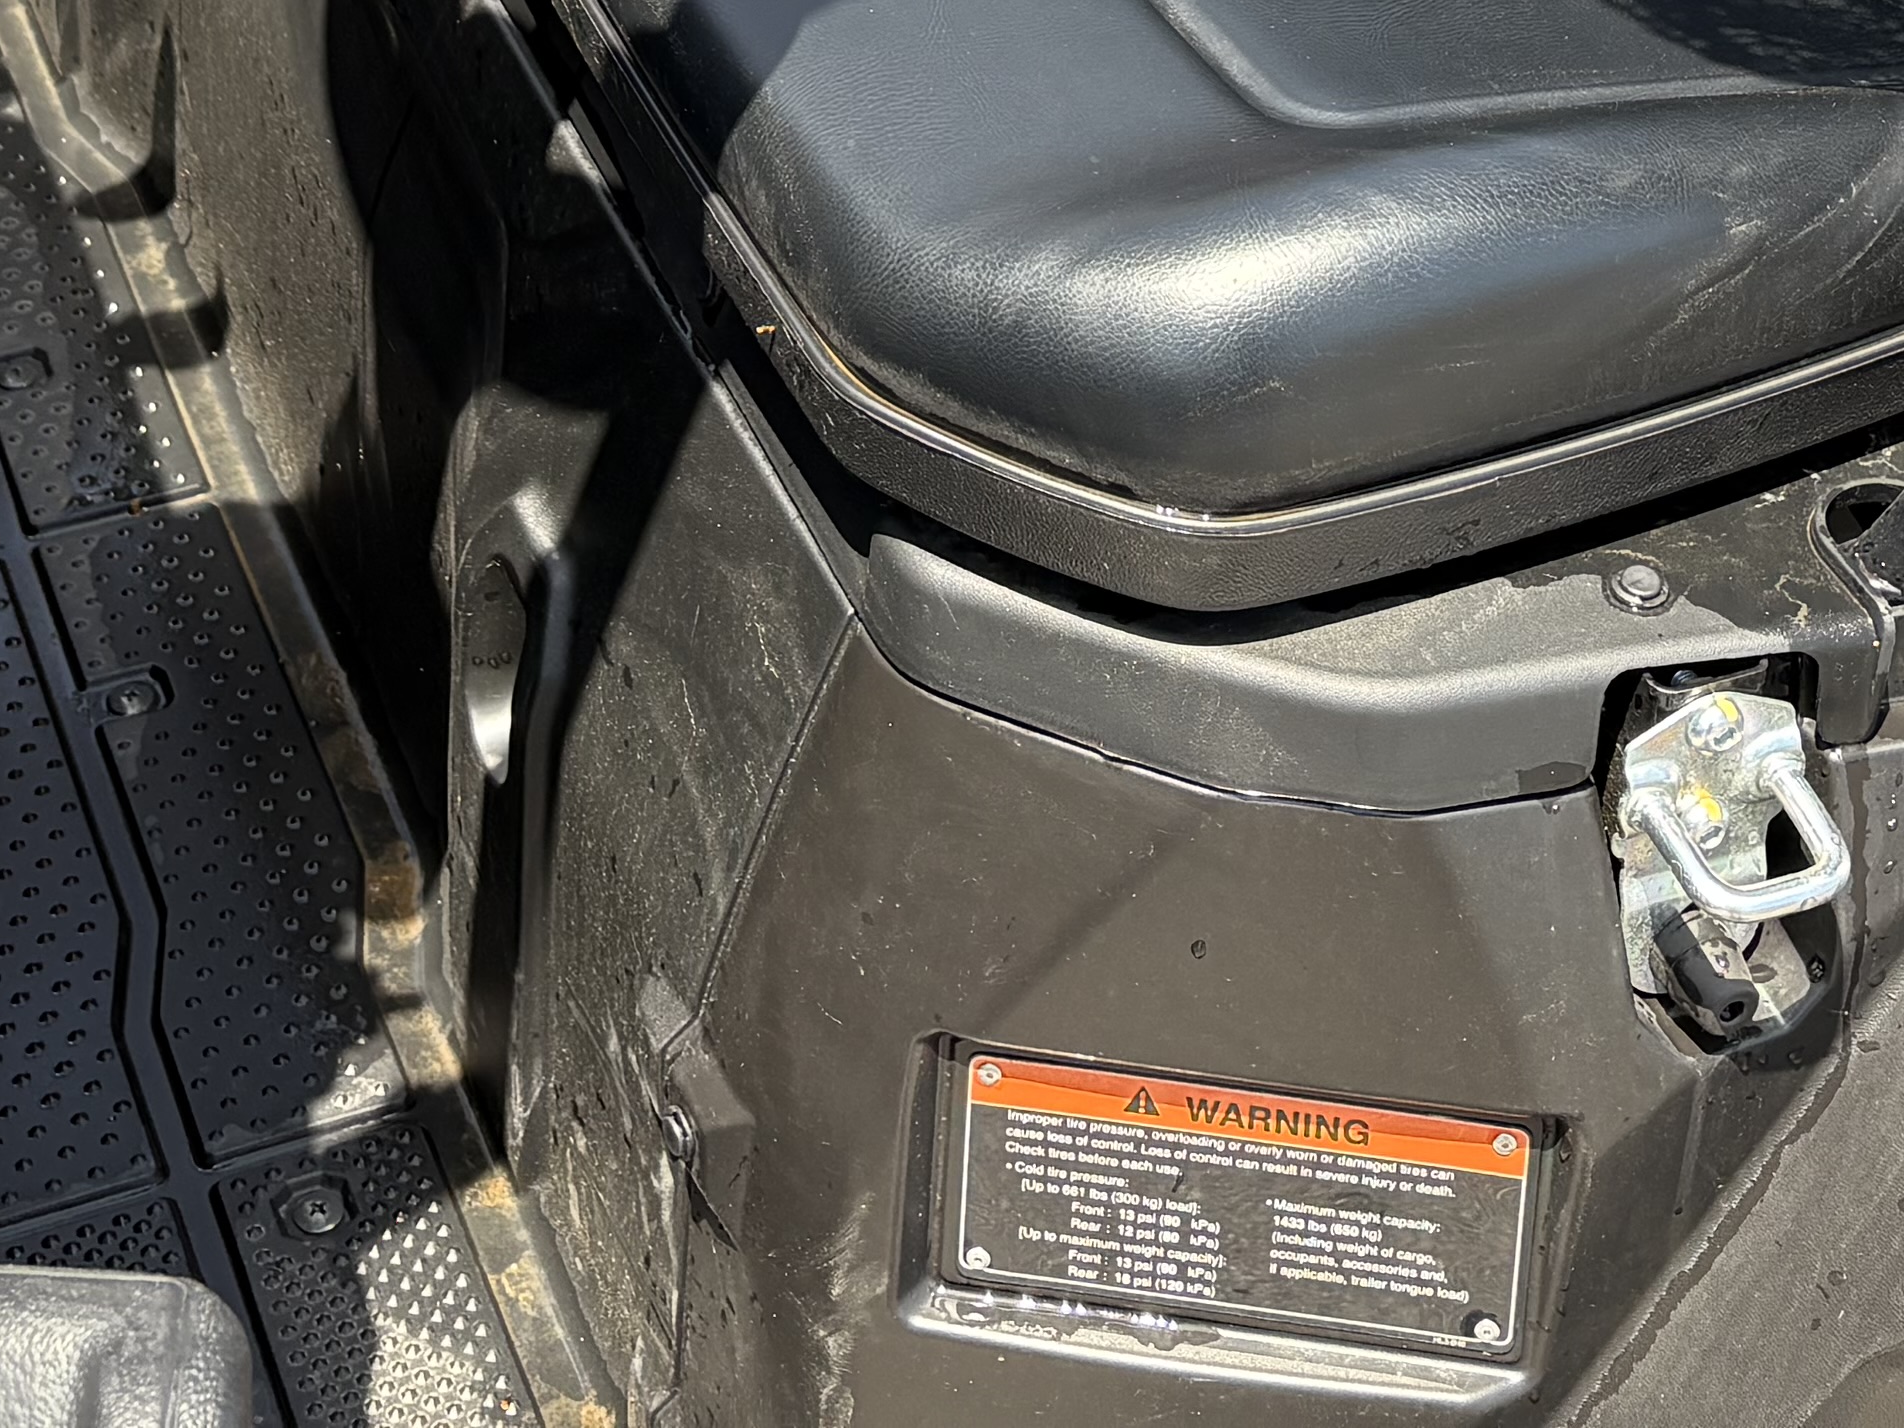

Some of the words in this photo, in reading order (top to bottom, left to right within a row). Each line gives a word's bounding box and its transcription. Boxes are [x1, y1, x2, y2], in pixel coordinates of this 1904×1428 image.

[1185, 1097, 1370, 1146] WARNING
[1005, 1142, 1045, 1157] Check
[1049, 1148, 1076, 1162] tires
[1079, 1152, 1118, 1168] before
[1122, 1158, 1153, 1173] each
[1007, 1109, 1063, 1129] Improper
[1067, 1118, 1086, 1130] tire
[1090, 1122, 1148, 1141] pressure,
[1152, 1130, 1225, 1152] overloading
[1228, 1142, 1242, 1153] or
[1245, 1144, 1283, 1160] overly
[1286, 1150, 1317, 1163] worn
[1321, 1155, 1334, 1165] or
[1338, 1156, 1396, 1175] damaged
[1400, 1165, 1427, 1178] tires
[1431, 1170, 1454, 1181] can
[1006, 1126, 1043, 1141] cause
[1047, 1131, 1072, 1144] loss
[1076, 1135, 1088, 1147] of
[1091, 1138, 1137, 1154] control.
[1141, 1144, 1172, 1159] Loss
[1175, 1148, 1187, 1160] of
[1190, 1151, 1232, 1167] control
[1235, 1159, 1259, 1171] can
[1262, 1161, 1297, 1176] result
[1300, 1167, 1312, 1178] in
[1316, 1170, 1358, 1185] severe
[1361, 1175, 1396, 1191] injury
[1400, 1181, 1413, 1192] or
[1416, 1183, 1456, 1198] death.
[1015, 1162, 1044, 1176] Cold
[1047, 1166, 1067, 1179] tire
[1070, 1170, 1129, 1189] pressure:
[1047, 1182, 1059, 1195] to
[1062, 1185, 1085, 1199] 661
[1090, 1189, 1108, 1202] lbs
[1111, 1192, 1139, 1207] (300
[1143, 1196, 1162, 1211] kg)
[1137, 1212, 1156, 1226] psi
[1191, 1219, 1220, 1235] kPa)
[1274, 1199, 1335, 1218] Maximum
[1339, 1209, 1381, 1227] weight
[1383, 1215, 1441, 1235] capacity:
[1044, 1231, 1056, 1243] to
[1059, 1233, 1120, 1252] maximum
[1123, 1242, 1164, 1260] weight
[1118, 1225, 1134, 1237] 12
[1136, 1228, 1155, 1242] psi
[1190, 1235, 1220, 1251] kPa)
[1308, 1221, 1327, 1233] lbs
[1362, 1228, 1382, 1243] kg)
[1270, 1248, 1339, 1269] occupants,
[1342, 1259, 1417, 1279] accessories
[1336, 1241, 1377, 1258] weight
[1380, 1247, 1393, 1259] of
[1134, 1260, 1153, 1274] psi
[1187, 1267, 1217, 1283] kPa)
[1280, 1266, 1347, 1287] applicable,
[1351, 1276, 1387, 1291] trailer
[1390, 1282, 1433, 1299] tongue
[1437, 1288, 1469, 1304] load)
[1134, 1275, 1153, 1289] psi
[1155, 1278, 1184, 1294] (120
[1187, 1283, 1216, 1299] kPa)
